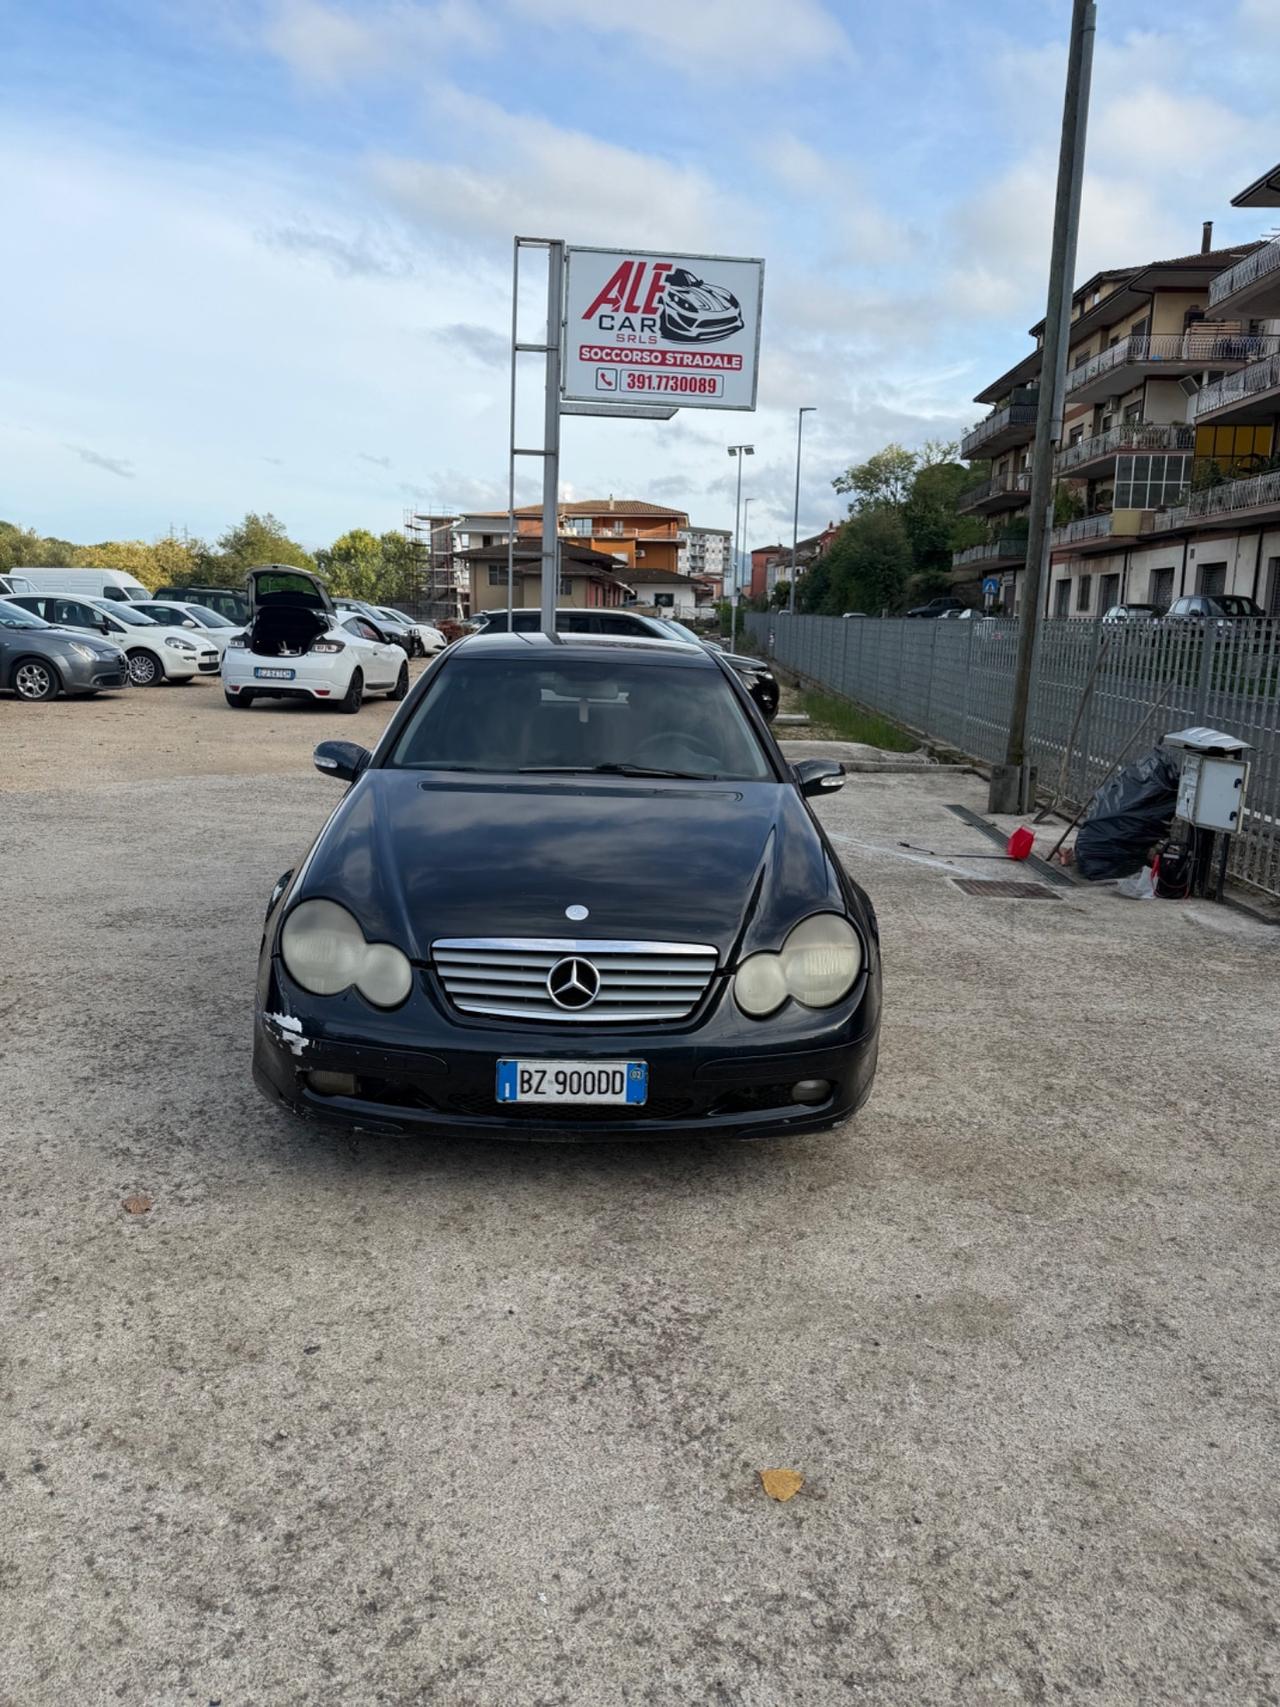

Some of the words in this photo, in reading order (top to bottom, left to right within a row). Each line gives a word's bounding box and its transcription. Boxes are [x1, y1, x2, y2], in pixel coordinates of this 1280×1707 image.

[581, 260, 673, 320] ALE
[599, 314, 657, 333] CAR
[616, 333, 657, 345] SRLS
[581, 347, 662, 364] SOCCORSO
[665, 353, 742, 369] STRADALE
[627, 373, 717, 394] 391.7730089
[520, 1069, 547, 1095] BZ
[554, 1070, 625, 1095] 900DD
